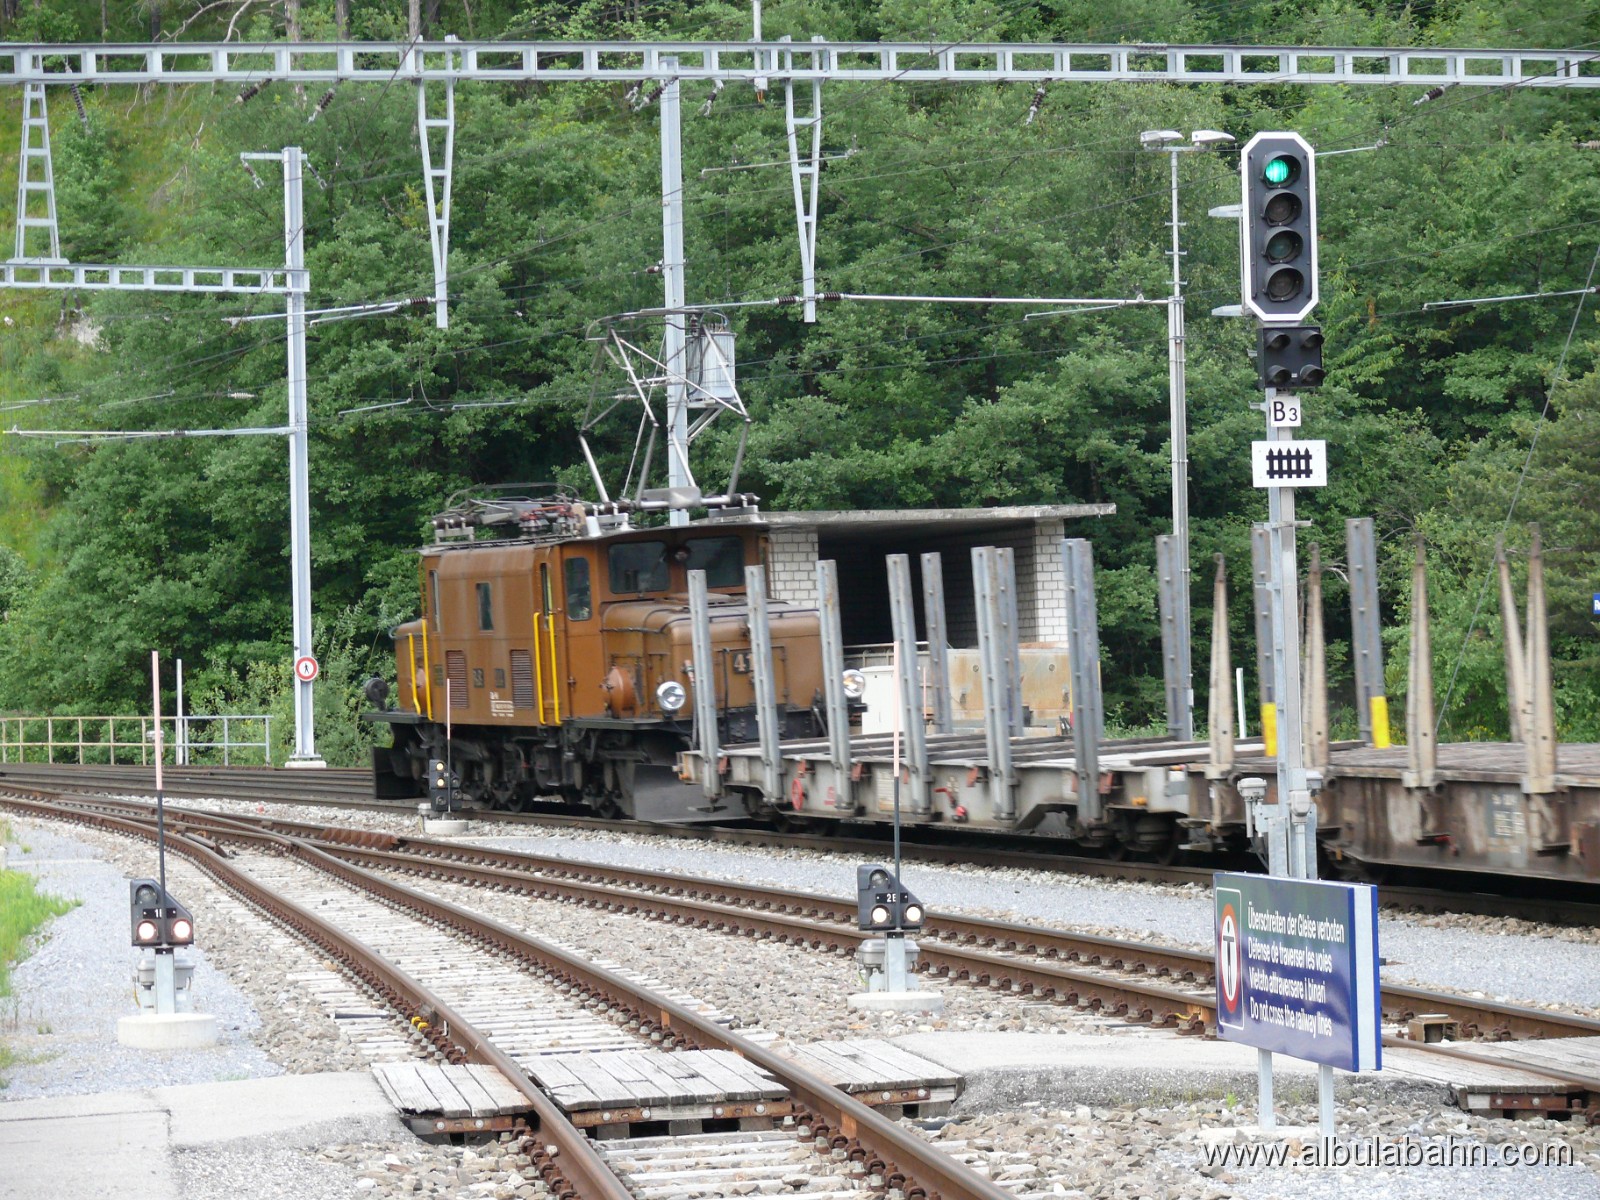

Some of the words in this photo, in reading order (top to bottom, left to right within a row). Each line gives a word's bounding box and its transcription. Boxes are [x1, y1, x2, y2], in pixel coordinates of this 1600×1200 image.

[1248, 901, 1286, 934] Überschreiten
[1287, 912, 1297, 936] der
[1298, 913, 1316, 939] Gleise
[1317, 917, 1345, 944] verboten
[1248, 936, 1270, 962] Défense
[1271, 941, 1279, 964] de
[1279, 942, 1305, 968] traverser
[1305, 946, 1315, 970] les
[1316, 948, 1333, 973] voies
[1249, 966, 1268, 992] Vietato
[1269, 971, 1304, 999] attraversare
[1308, 977, 1326, 1004] binari
[1250, 996, 1259, 1020] Do
[1259, 1000, 1269, 1022] not
[1269, 1005, 1284, 1026] cross
[1284, 1004, 1295, 1029] the
[1296, 1007, 1317, 1038] railway
[1317, 1011, 1332, 1037] lines
